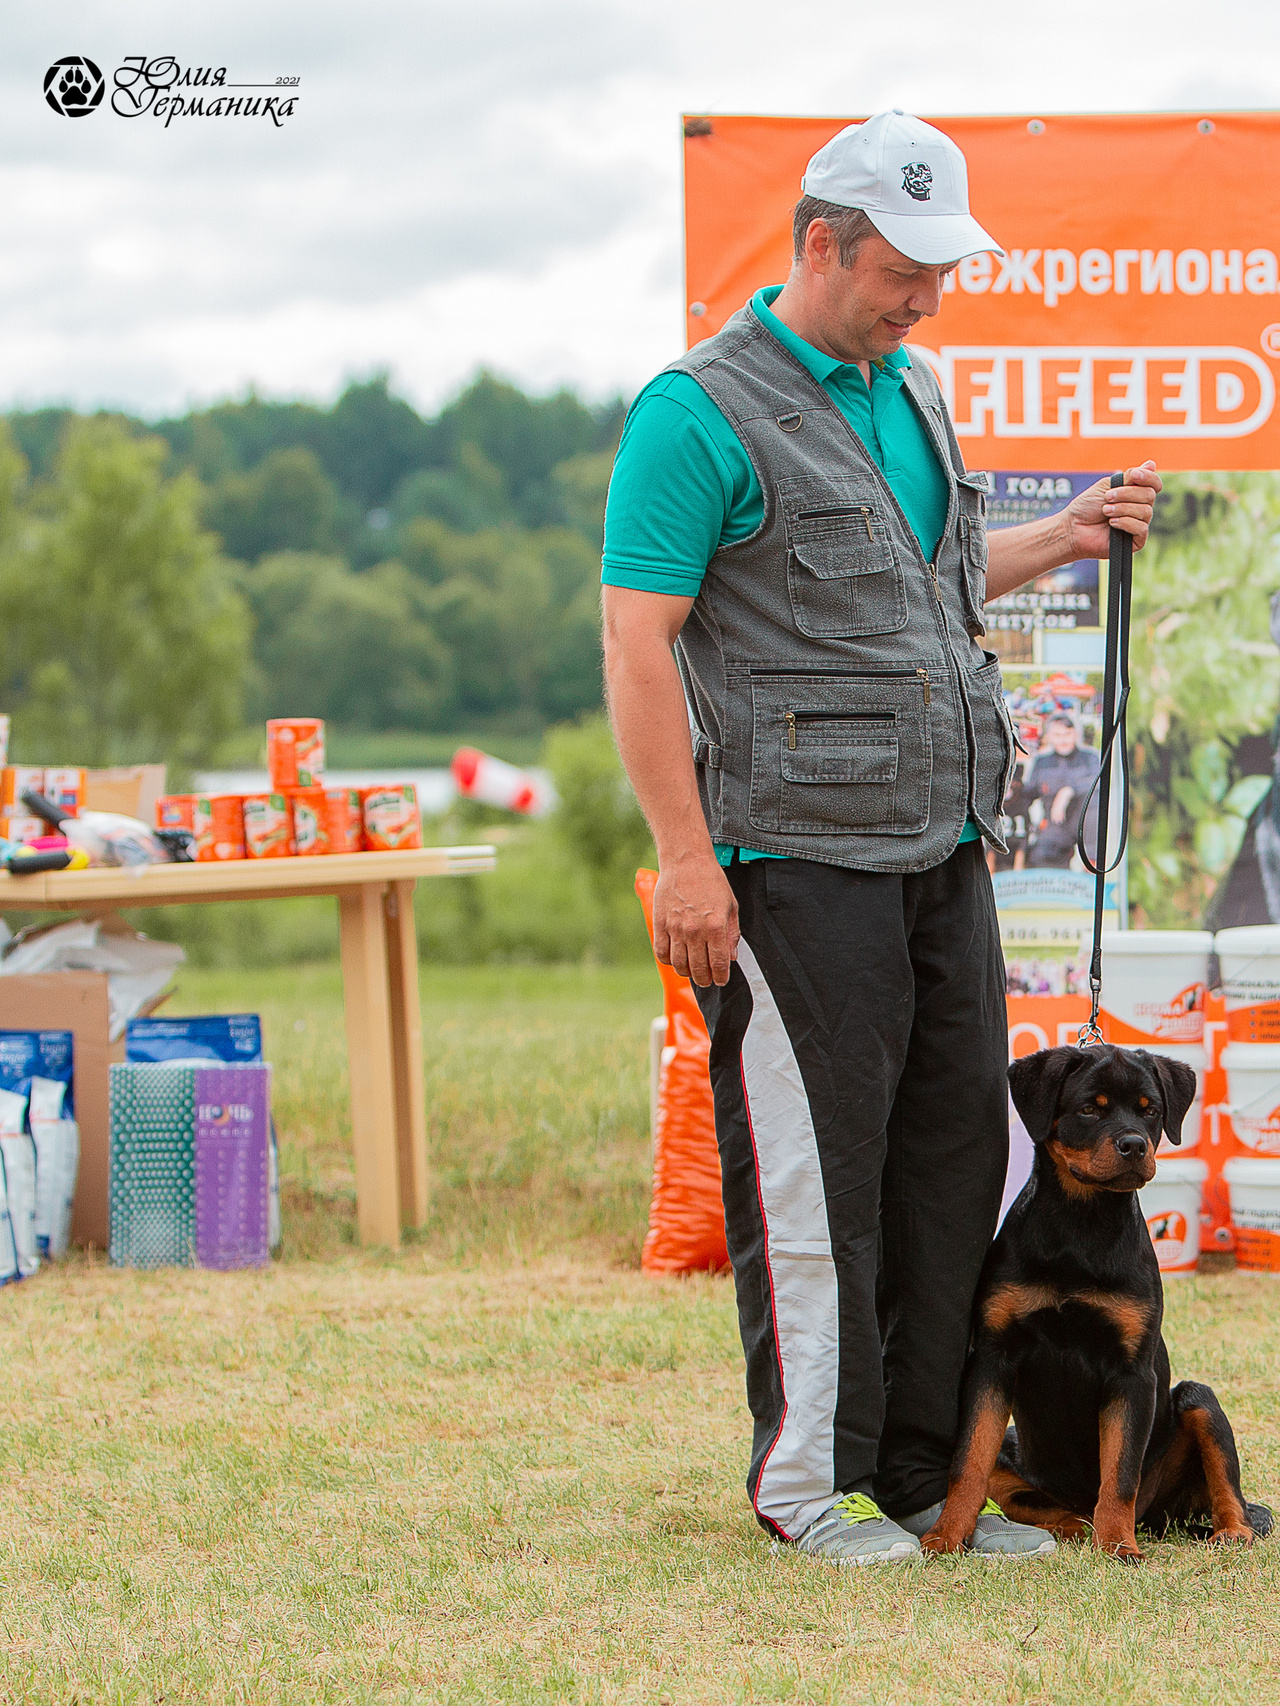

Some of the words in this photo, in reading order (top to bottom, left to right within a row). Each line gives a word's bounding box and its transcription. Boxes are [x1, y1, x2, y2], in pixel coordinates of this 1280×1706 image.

[902, 344, 1276, 438] FIFEED
[1006, 477, 1073, 500] года
[985, 614, 1077, 635] татусом
